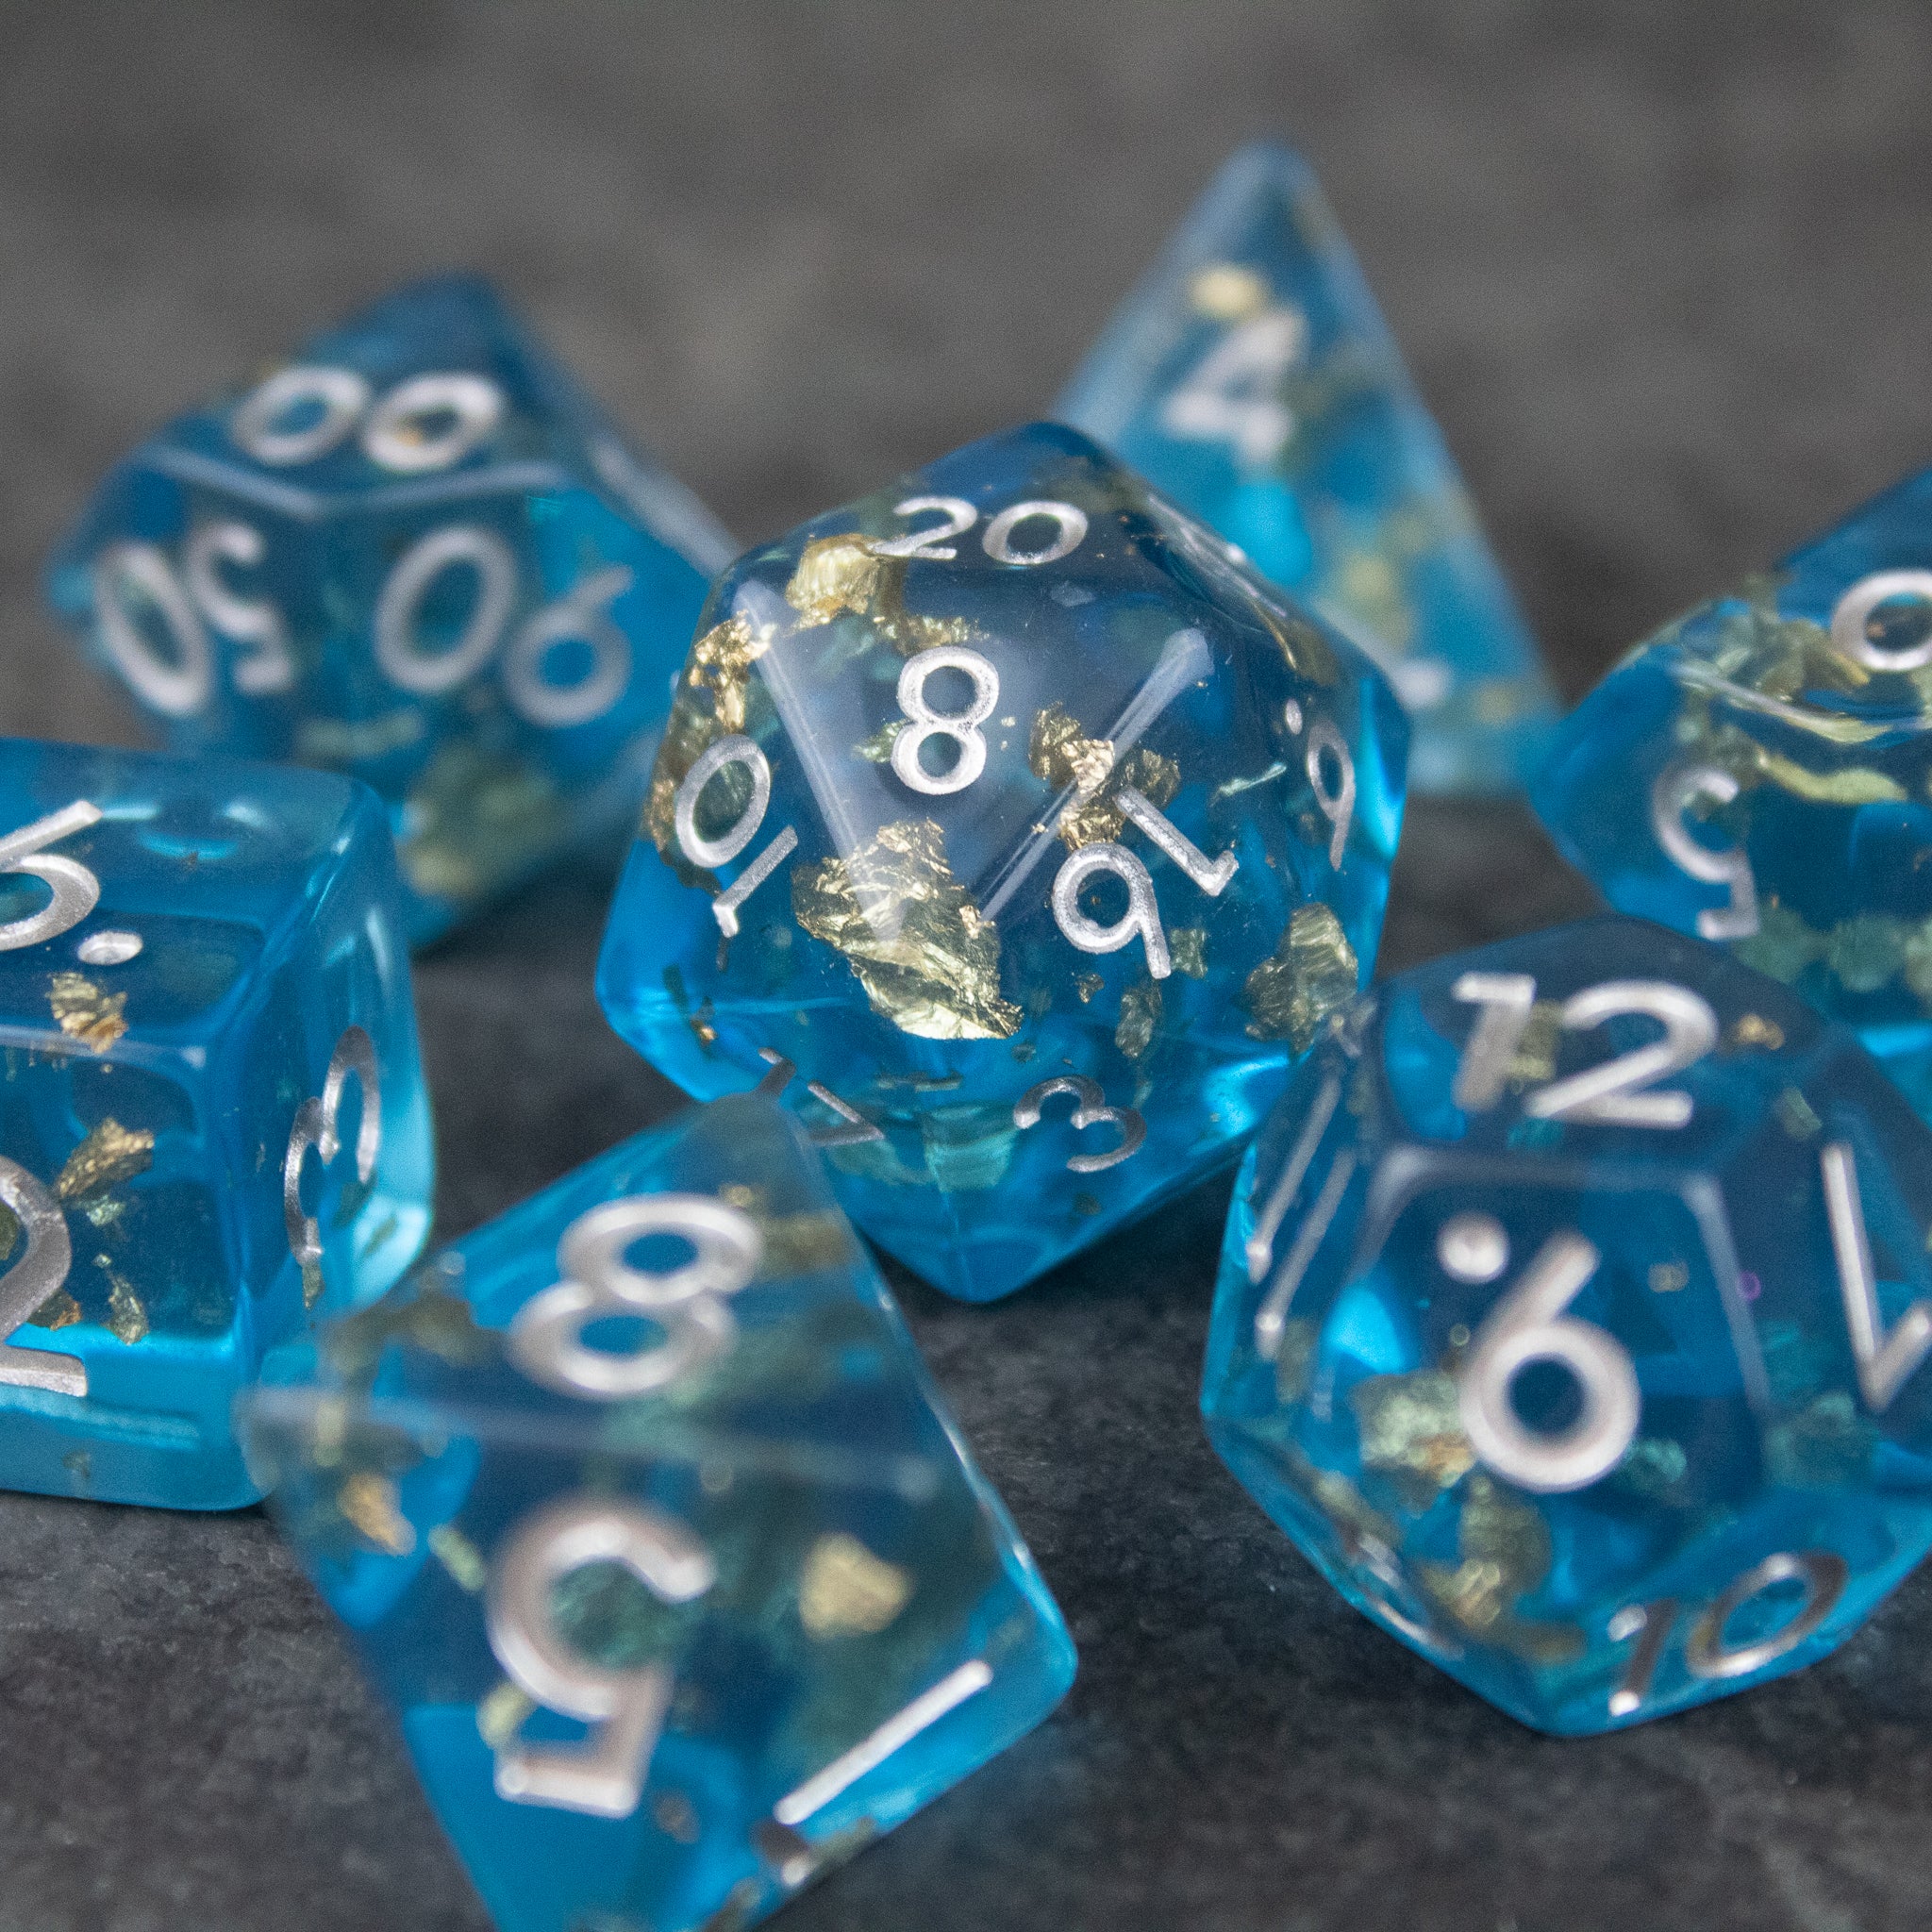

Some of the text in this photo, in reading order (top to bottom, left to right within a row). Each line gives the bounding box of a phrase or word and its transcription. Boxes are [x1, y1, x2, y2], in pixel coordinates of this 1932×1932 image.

[234, 366, 504, 469] 00
[871, 496, 1089, 564] 20
[890, 646, 1000, 796] 8
[1653, 766, 1760, 941] 5
[1013, 1074, 1147, 1173] 3
[1453, 972, 1719, 1130] 12
[509, 1192, 761, 1398] 8
[489, 1500, 715, 1817] 5
